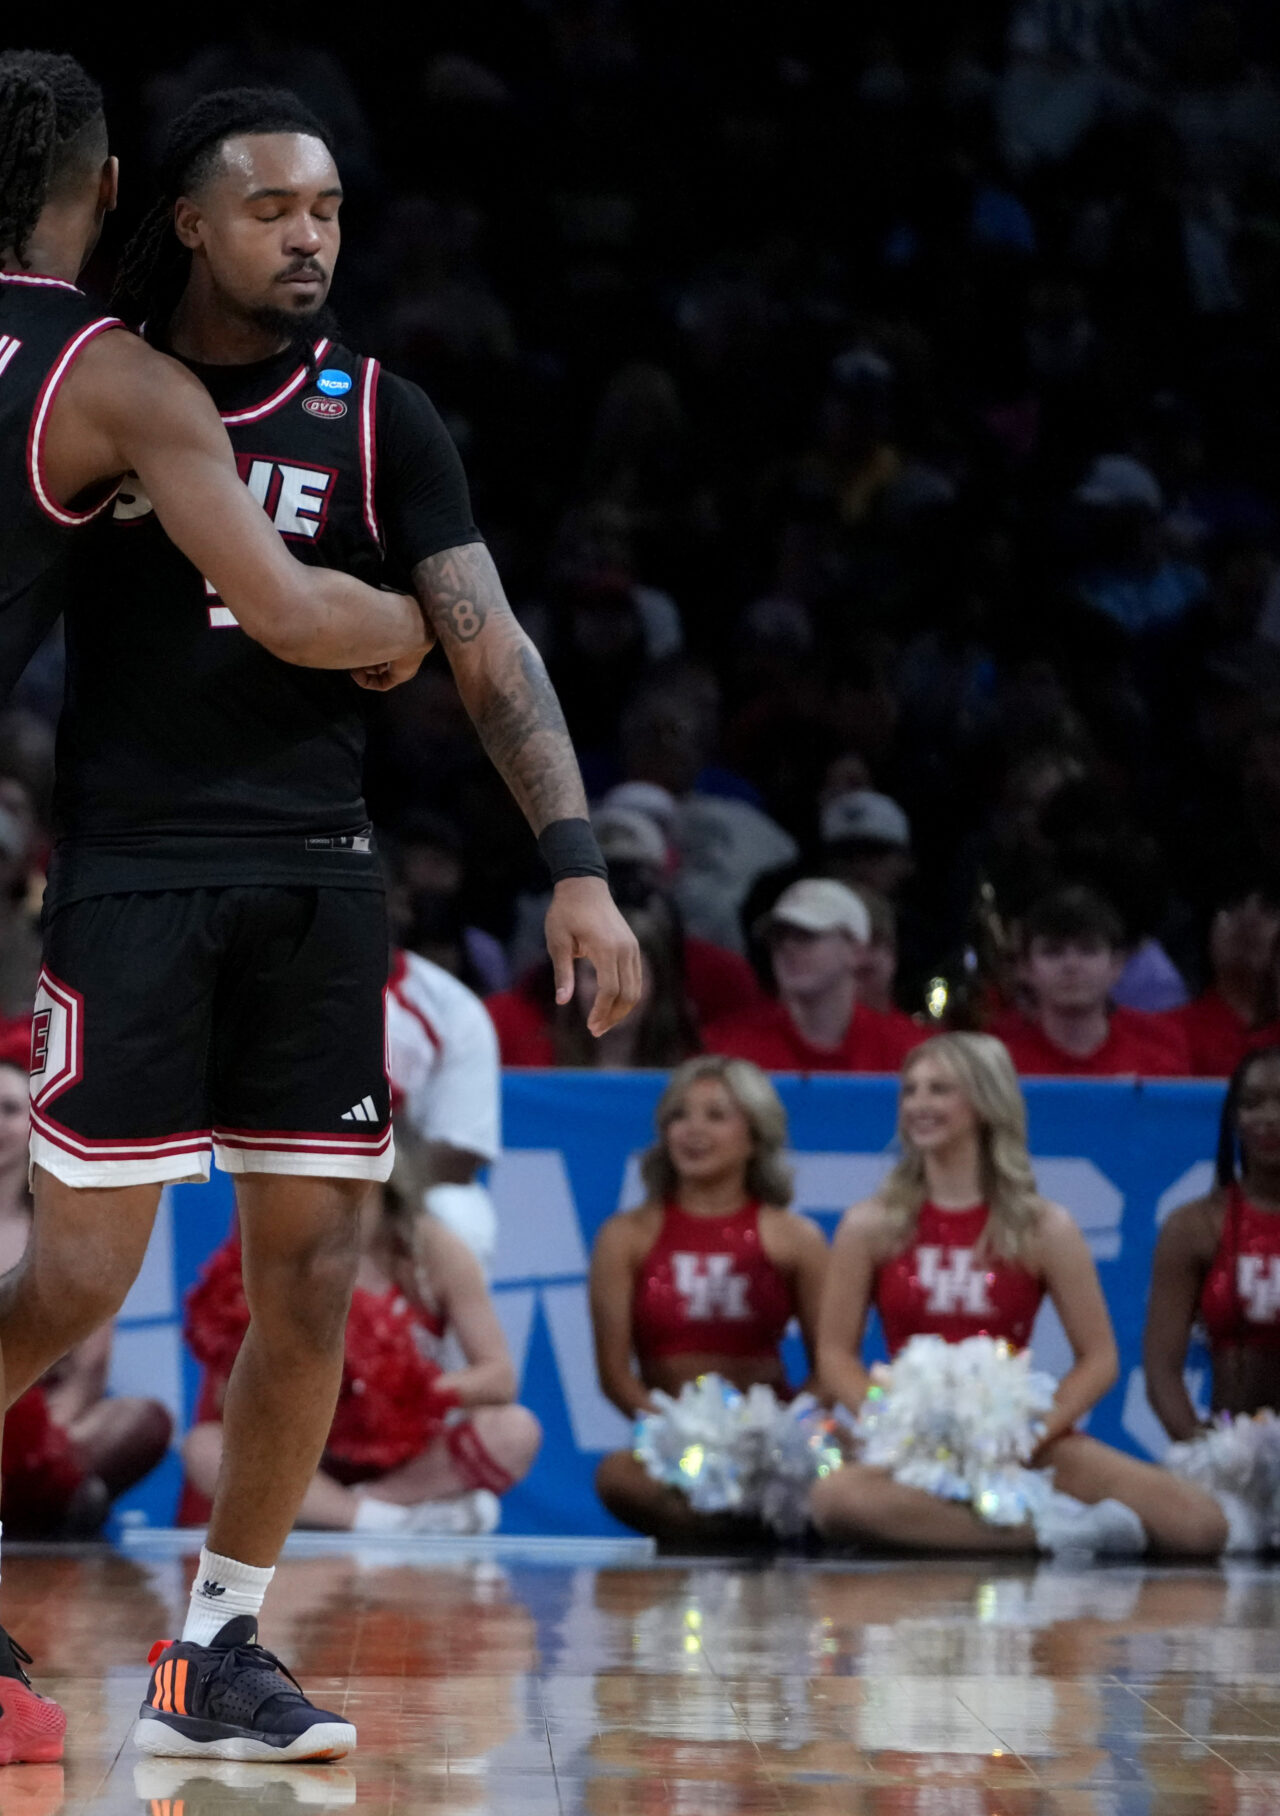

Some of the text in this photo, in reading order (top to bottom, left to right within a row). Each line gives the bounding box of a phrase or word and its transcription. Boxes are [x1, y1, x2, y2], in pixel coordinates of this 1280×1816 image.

[320, 378, 350, 390] NCAA
[310, 401, 338, 413] OVC
[30, 1008, 52, 1076] E
